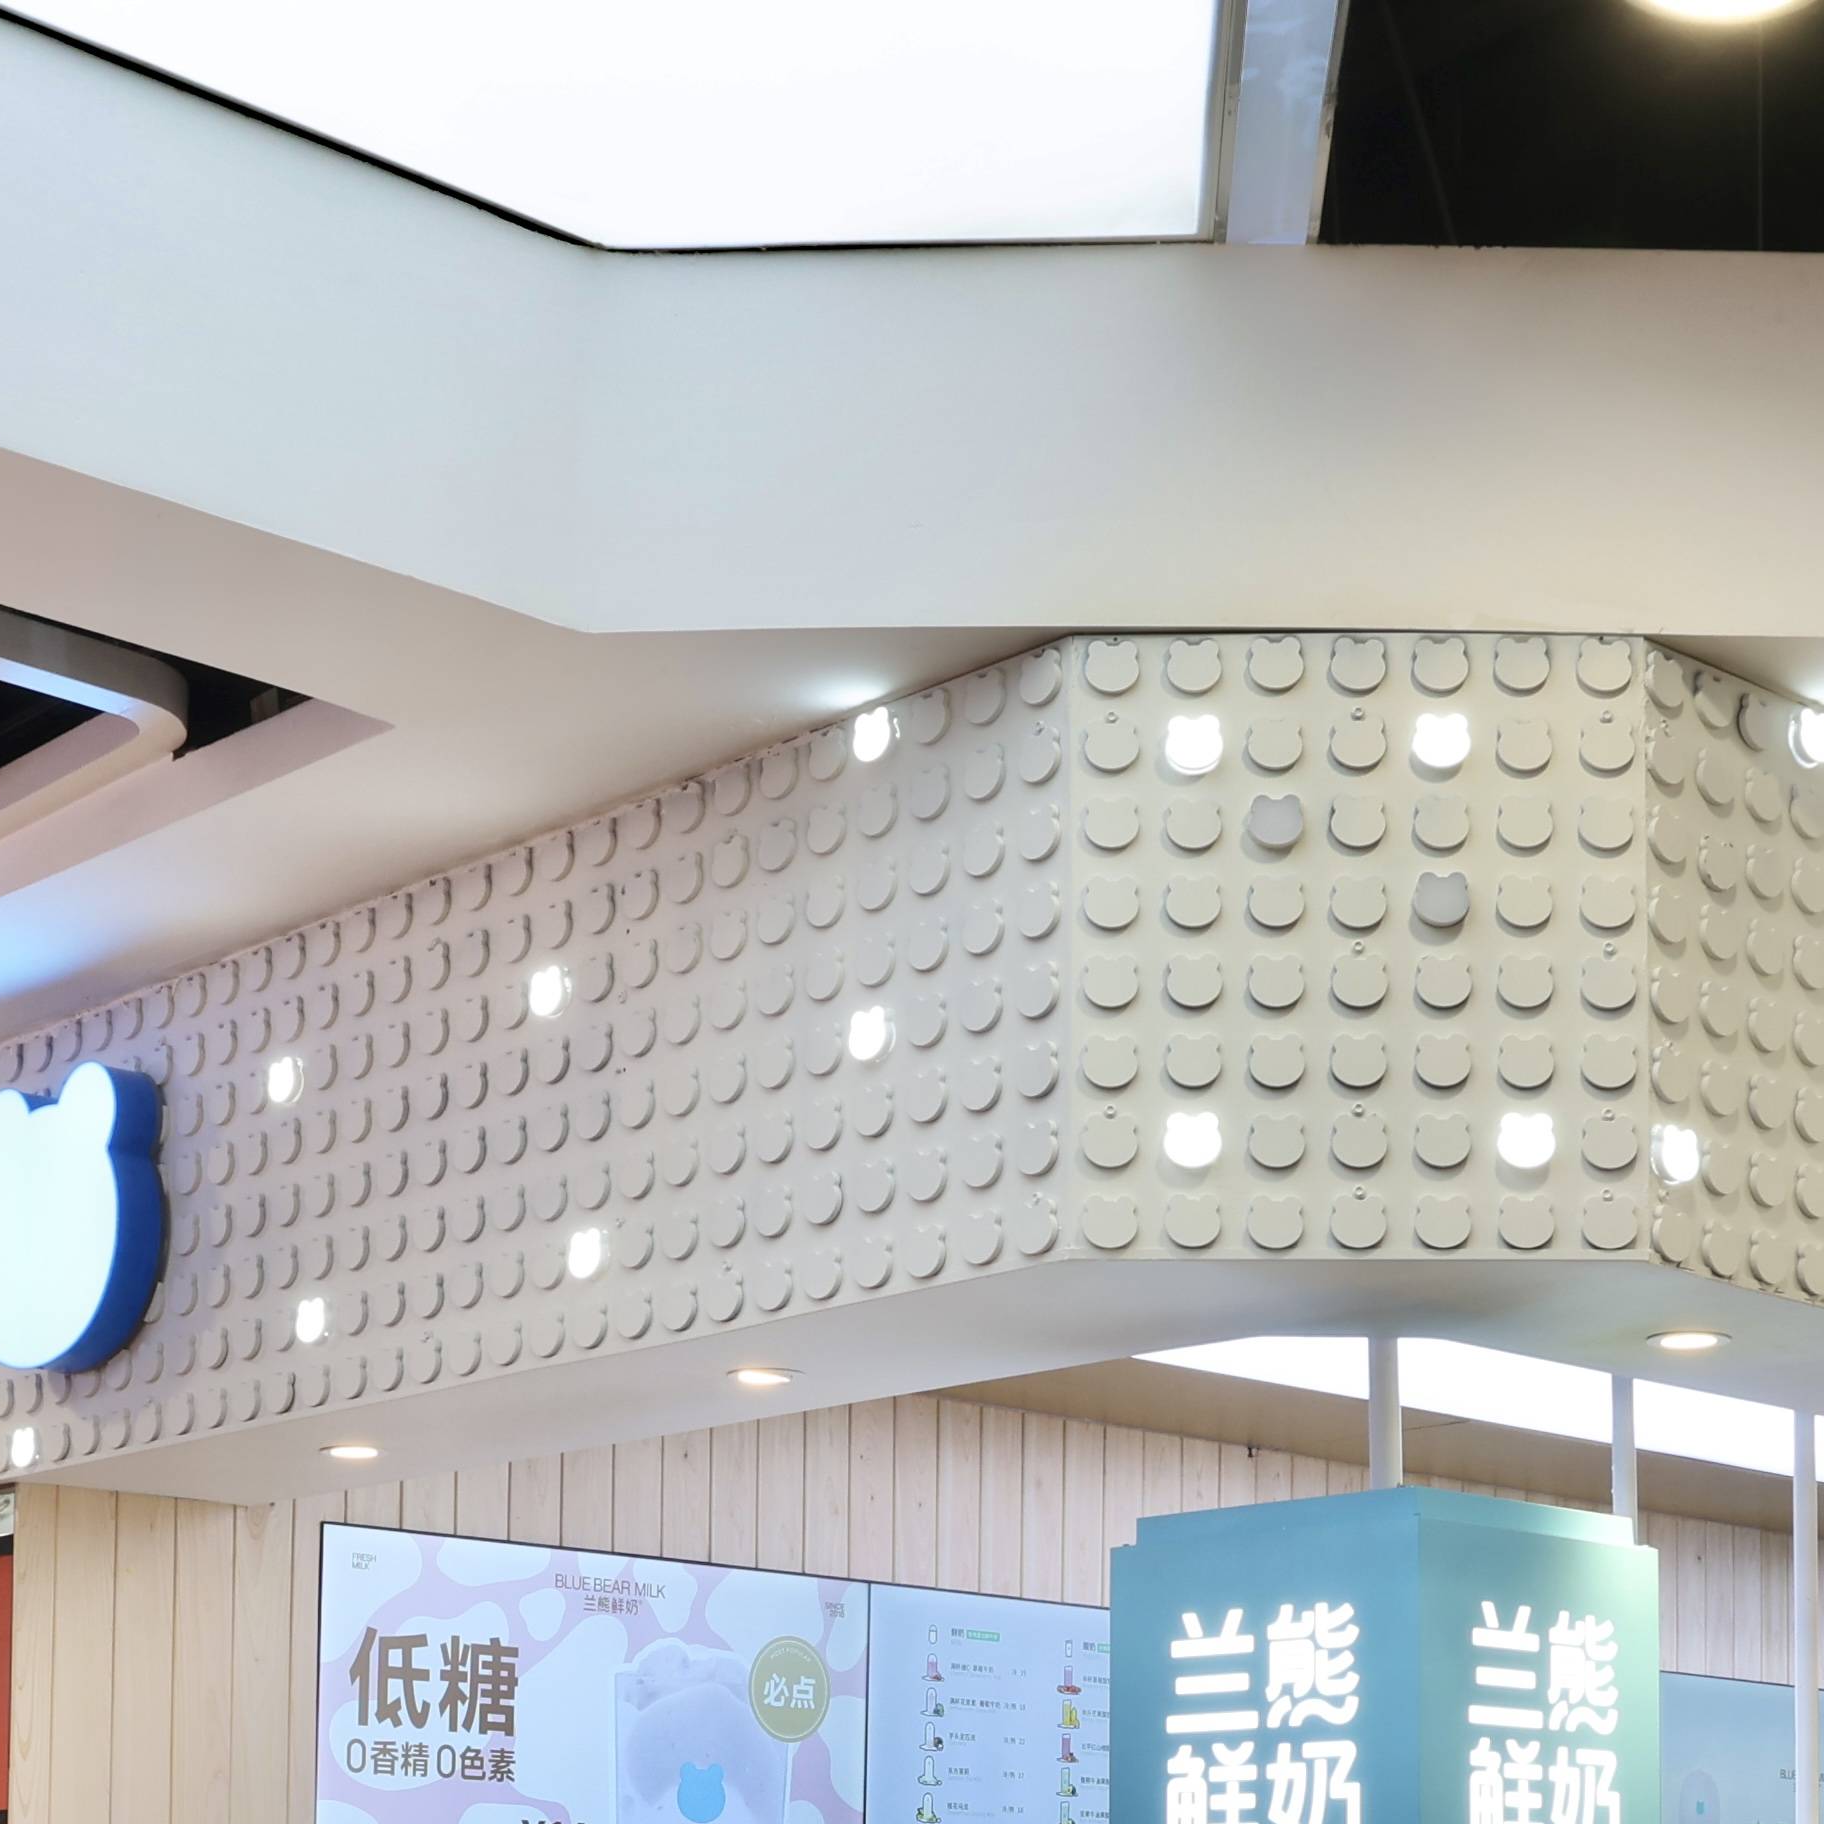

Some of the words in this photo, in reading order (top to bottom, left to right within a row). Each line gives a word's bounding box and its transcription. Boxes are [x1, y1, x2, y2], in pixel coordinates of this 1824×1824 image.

[554, 1574, 591, 1591] BLUE
[593, 1577, 631, 1595] BEAR
[634, 1581, 666, 1599] MILK
[349, 1626, 519, 1737] 低糖
[763, 1674, 817, 1709] 必点
[1166, 1600, 1361, 1735] 兰熊
[1468, 1600, 1619, 1736] 兰熊
[346, 1738, 430, 1778] 0香精
[436, 1744, 516, 1783] 0色素
